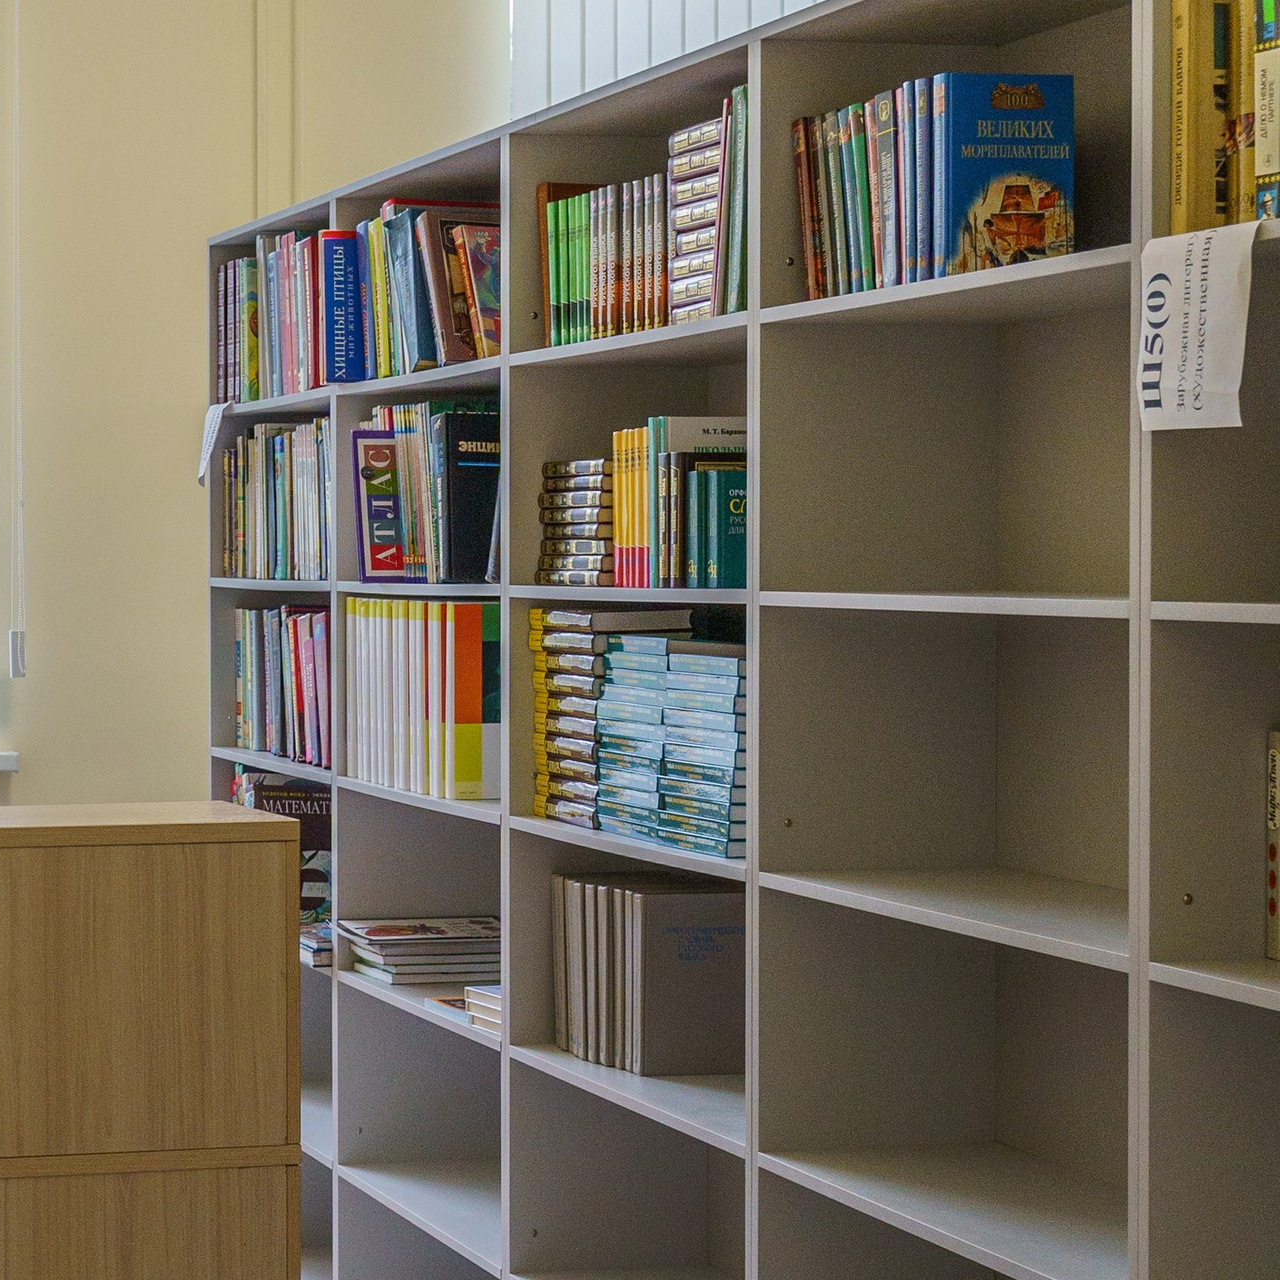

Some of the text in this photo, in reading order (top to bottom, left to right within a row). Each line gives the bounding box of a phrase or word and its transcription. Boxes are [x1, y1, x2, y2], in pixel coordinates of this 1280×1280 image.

[961, 143, 1070, 160] МОРЕПЛАВАТЕЛЕЙ
[976, 119, 1055, 140] ВЕЛИКИХ
[1174, 47, 1184, 206] ДЖОРДЖ ГОРДОН БАЙРОН
[332, 245, 346, 378] ХИЩНЫЕ ПТИЦЫ
[347, 265, 355, 331] ЖИВОТНЫХ
[1141, 272, 1172, 412] Ш5(0)
[1191, 229, 1218, 411] (художественная)
[1175, 311, 1190, 413] Зарубежная
[367, 449, 398, 567] АТЛАС
